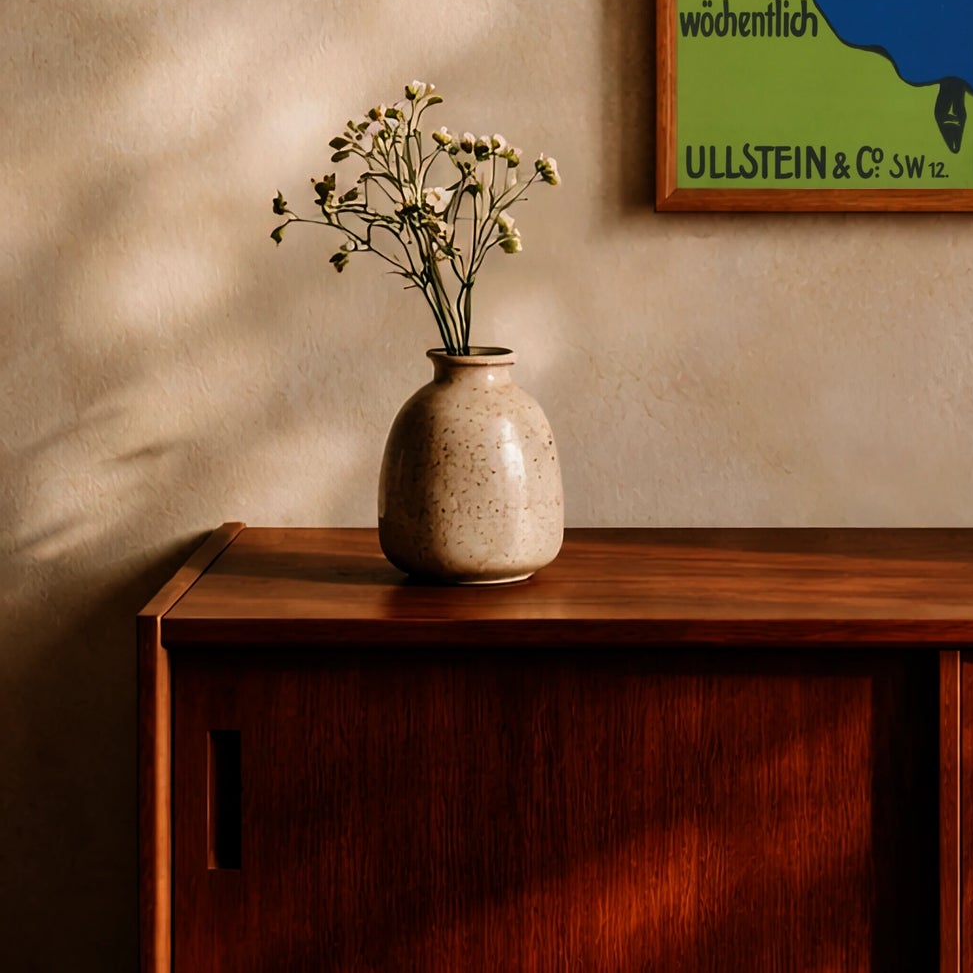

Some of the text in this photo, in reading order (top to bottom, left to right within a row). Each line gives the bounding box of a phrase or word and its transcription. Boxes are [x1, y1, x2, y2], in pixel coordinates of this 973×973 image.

[680, 0, 818, 37] wöchentlich
[686, 143, 827, 179] ULLSTEIN
[832, 152, 851, 179] &
